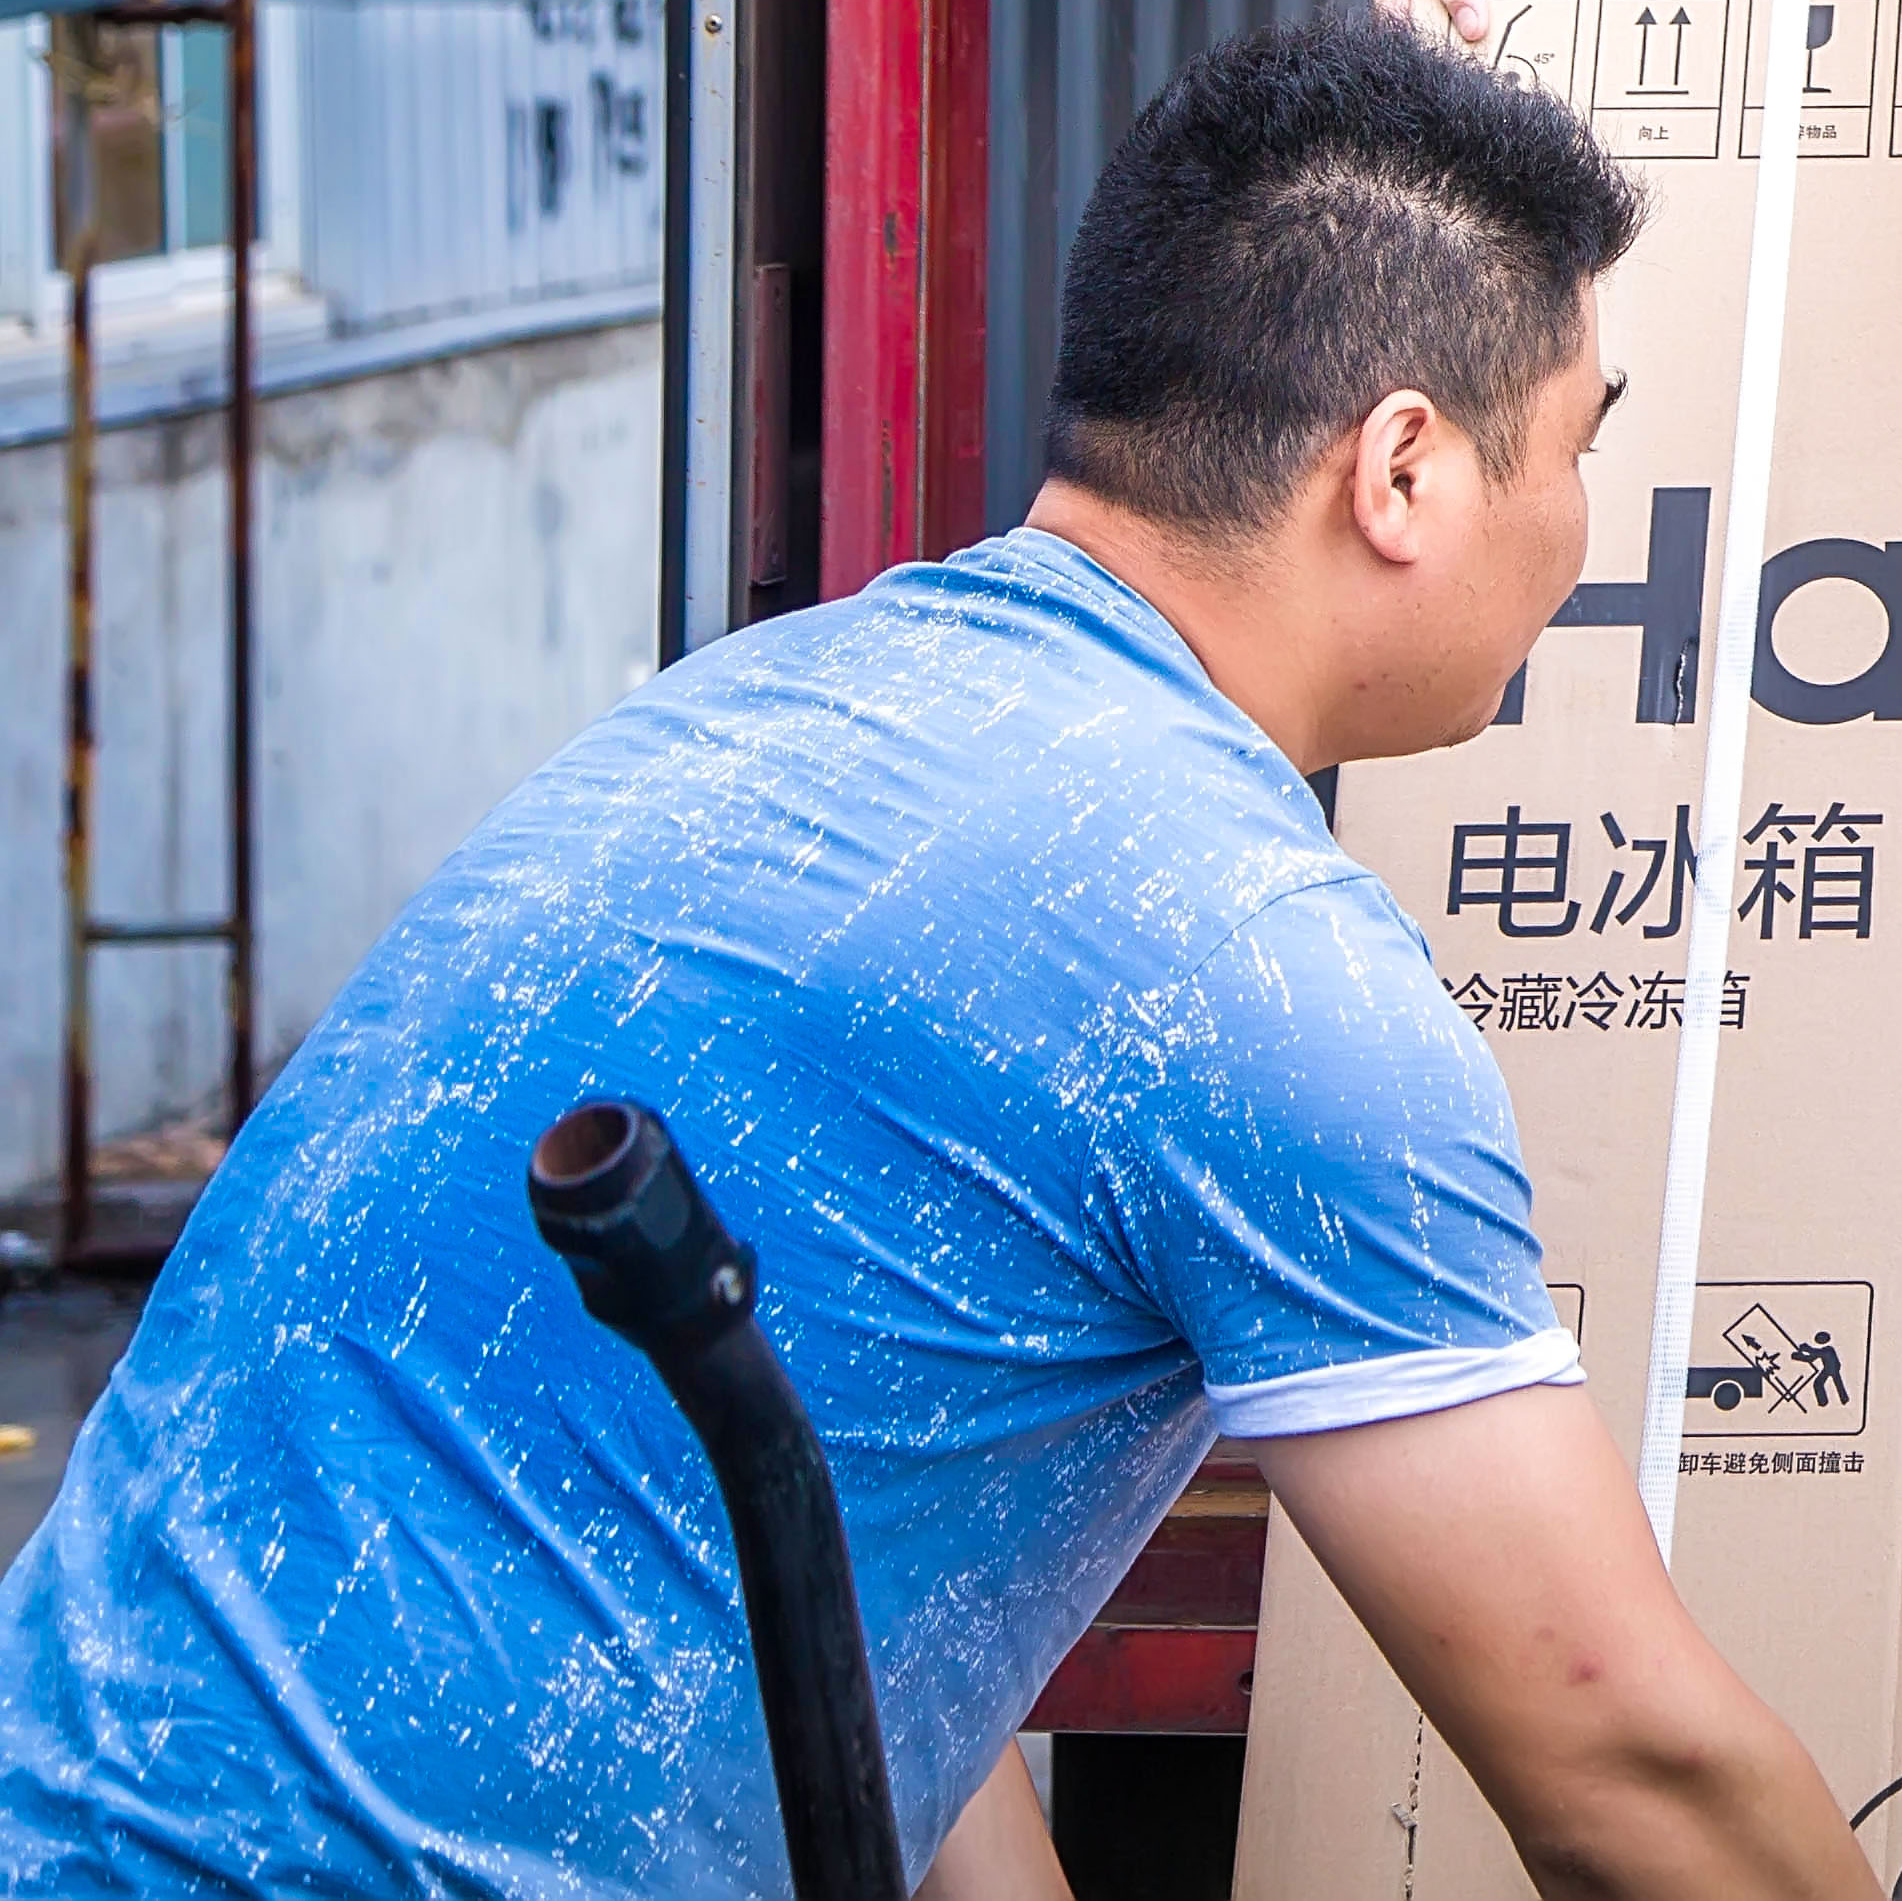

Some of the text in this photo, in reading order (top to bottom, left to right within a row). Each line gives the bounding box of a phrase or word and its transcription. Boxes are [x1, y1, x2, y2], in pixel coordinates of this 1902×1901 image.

[1637, 124, 1669, 141] 向上
[1444, 802, 1884, 941] 电冰箱
[1676, 1450, 1865, 1475] 卸车避免侧面撞击
